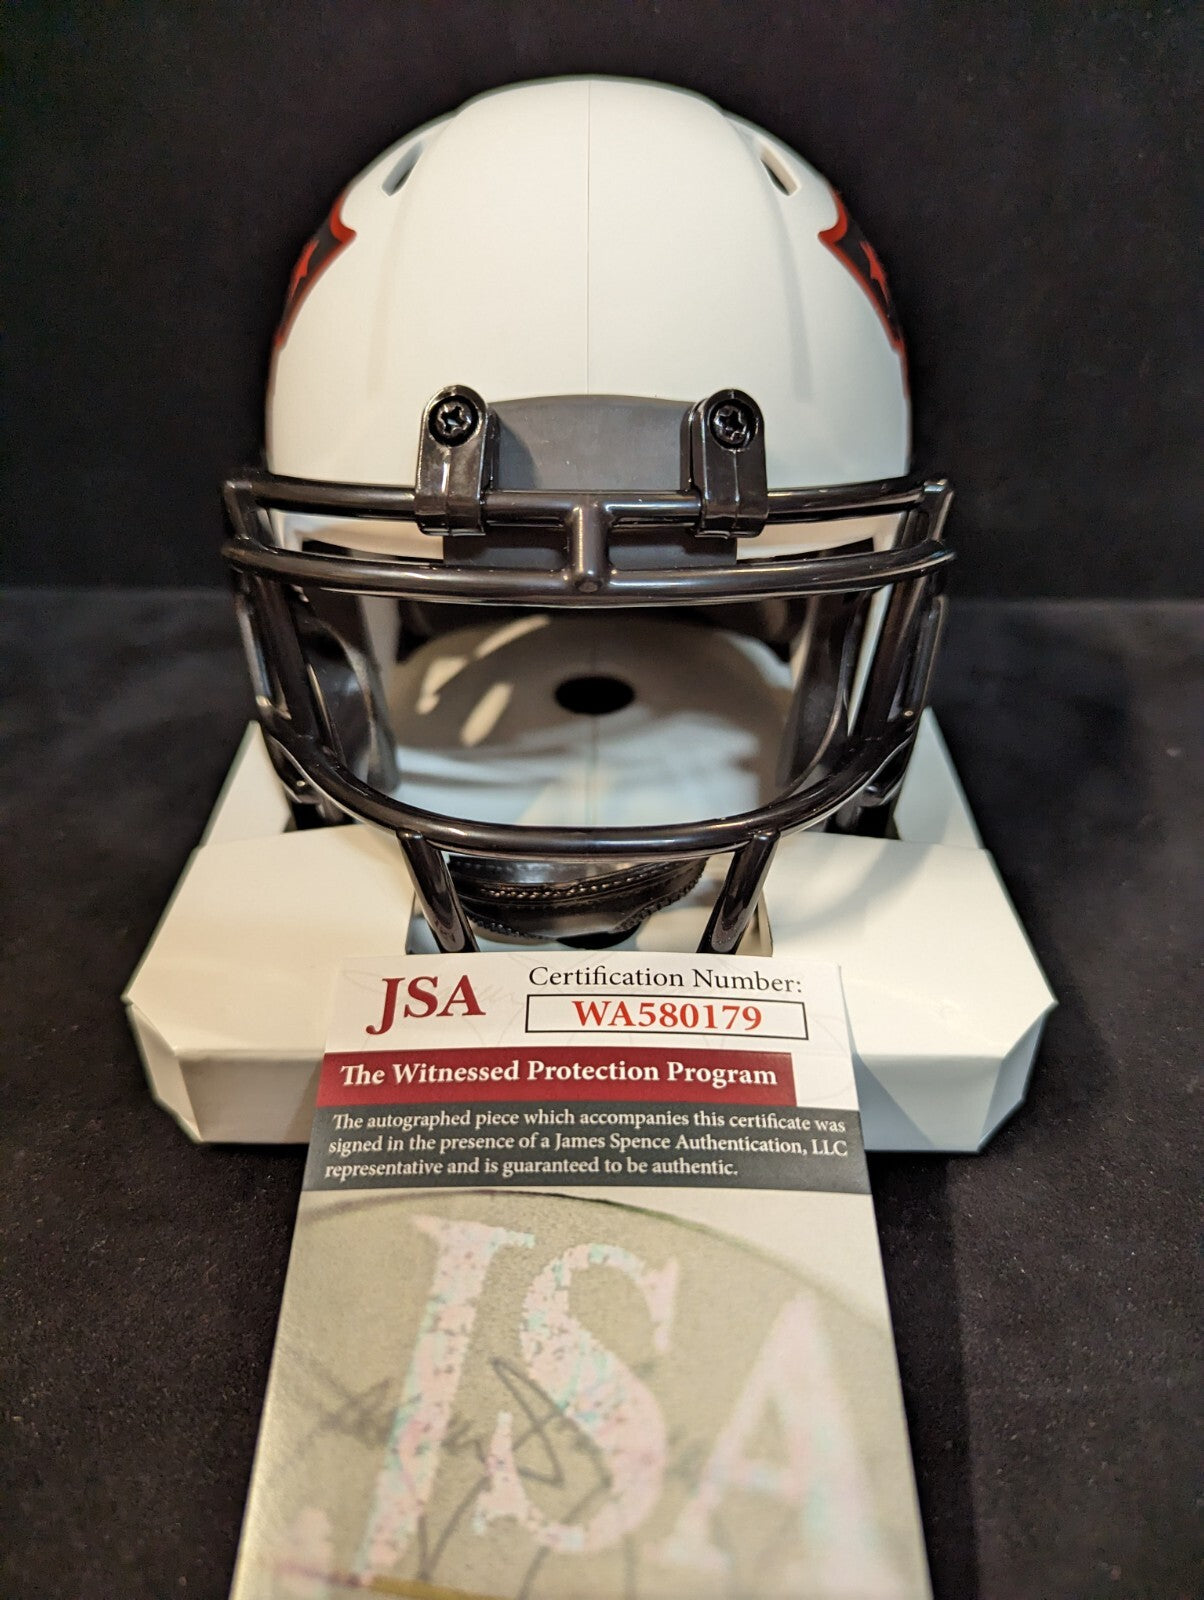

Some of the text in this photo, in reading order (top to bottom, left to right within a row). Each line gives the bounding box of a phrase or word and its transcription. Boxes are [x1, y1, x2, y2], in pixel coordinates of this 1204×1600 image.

[528, 965, 802, 993] Certification Number:
[365, 974, 486, 1035] JSA
[571, 1000, 762, 1031] WA580179
[340, 1060, 778, 1089] The Witnessed Protection Program
[333, 1108, 846, 1133] The autographed piece which accompanies this certificate was
[328, 1131, 848, 1157] signed in the presence of a James Spence Authentication, LLC
[324, 1155, 739, 1183] representative and is guaranteed to be authentic.
